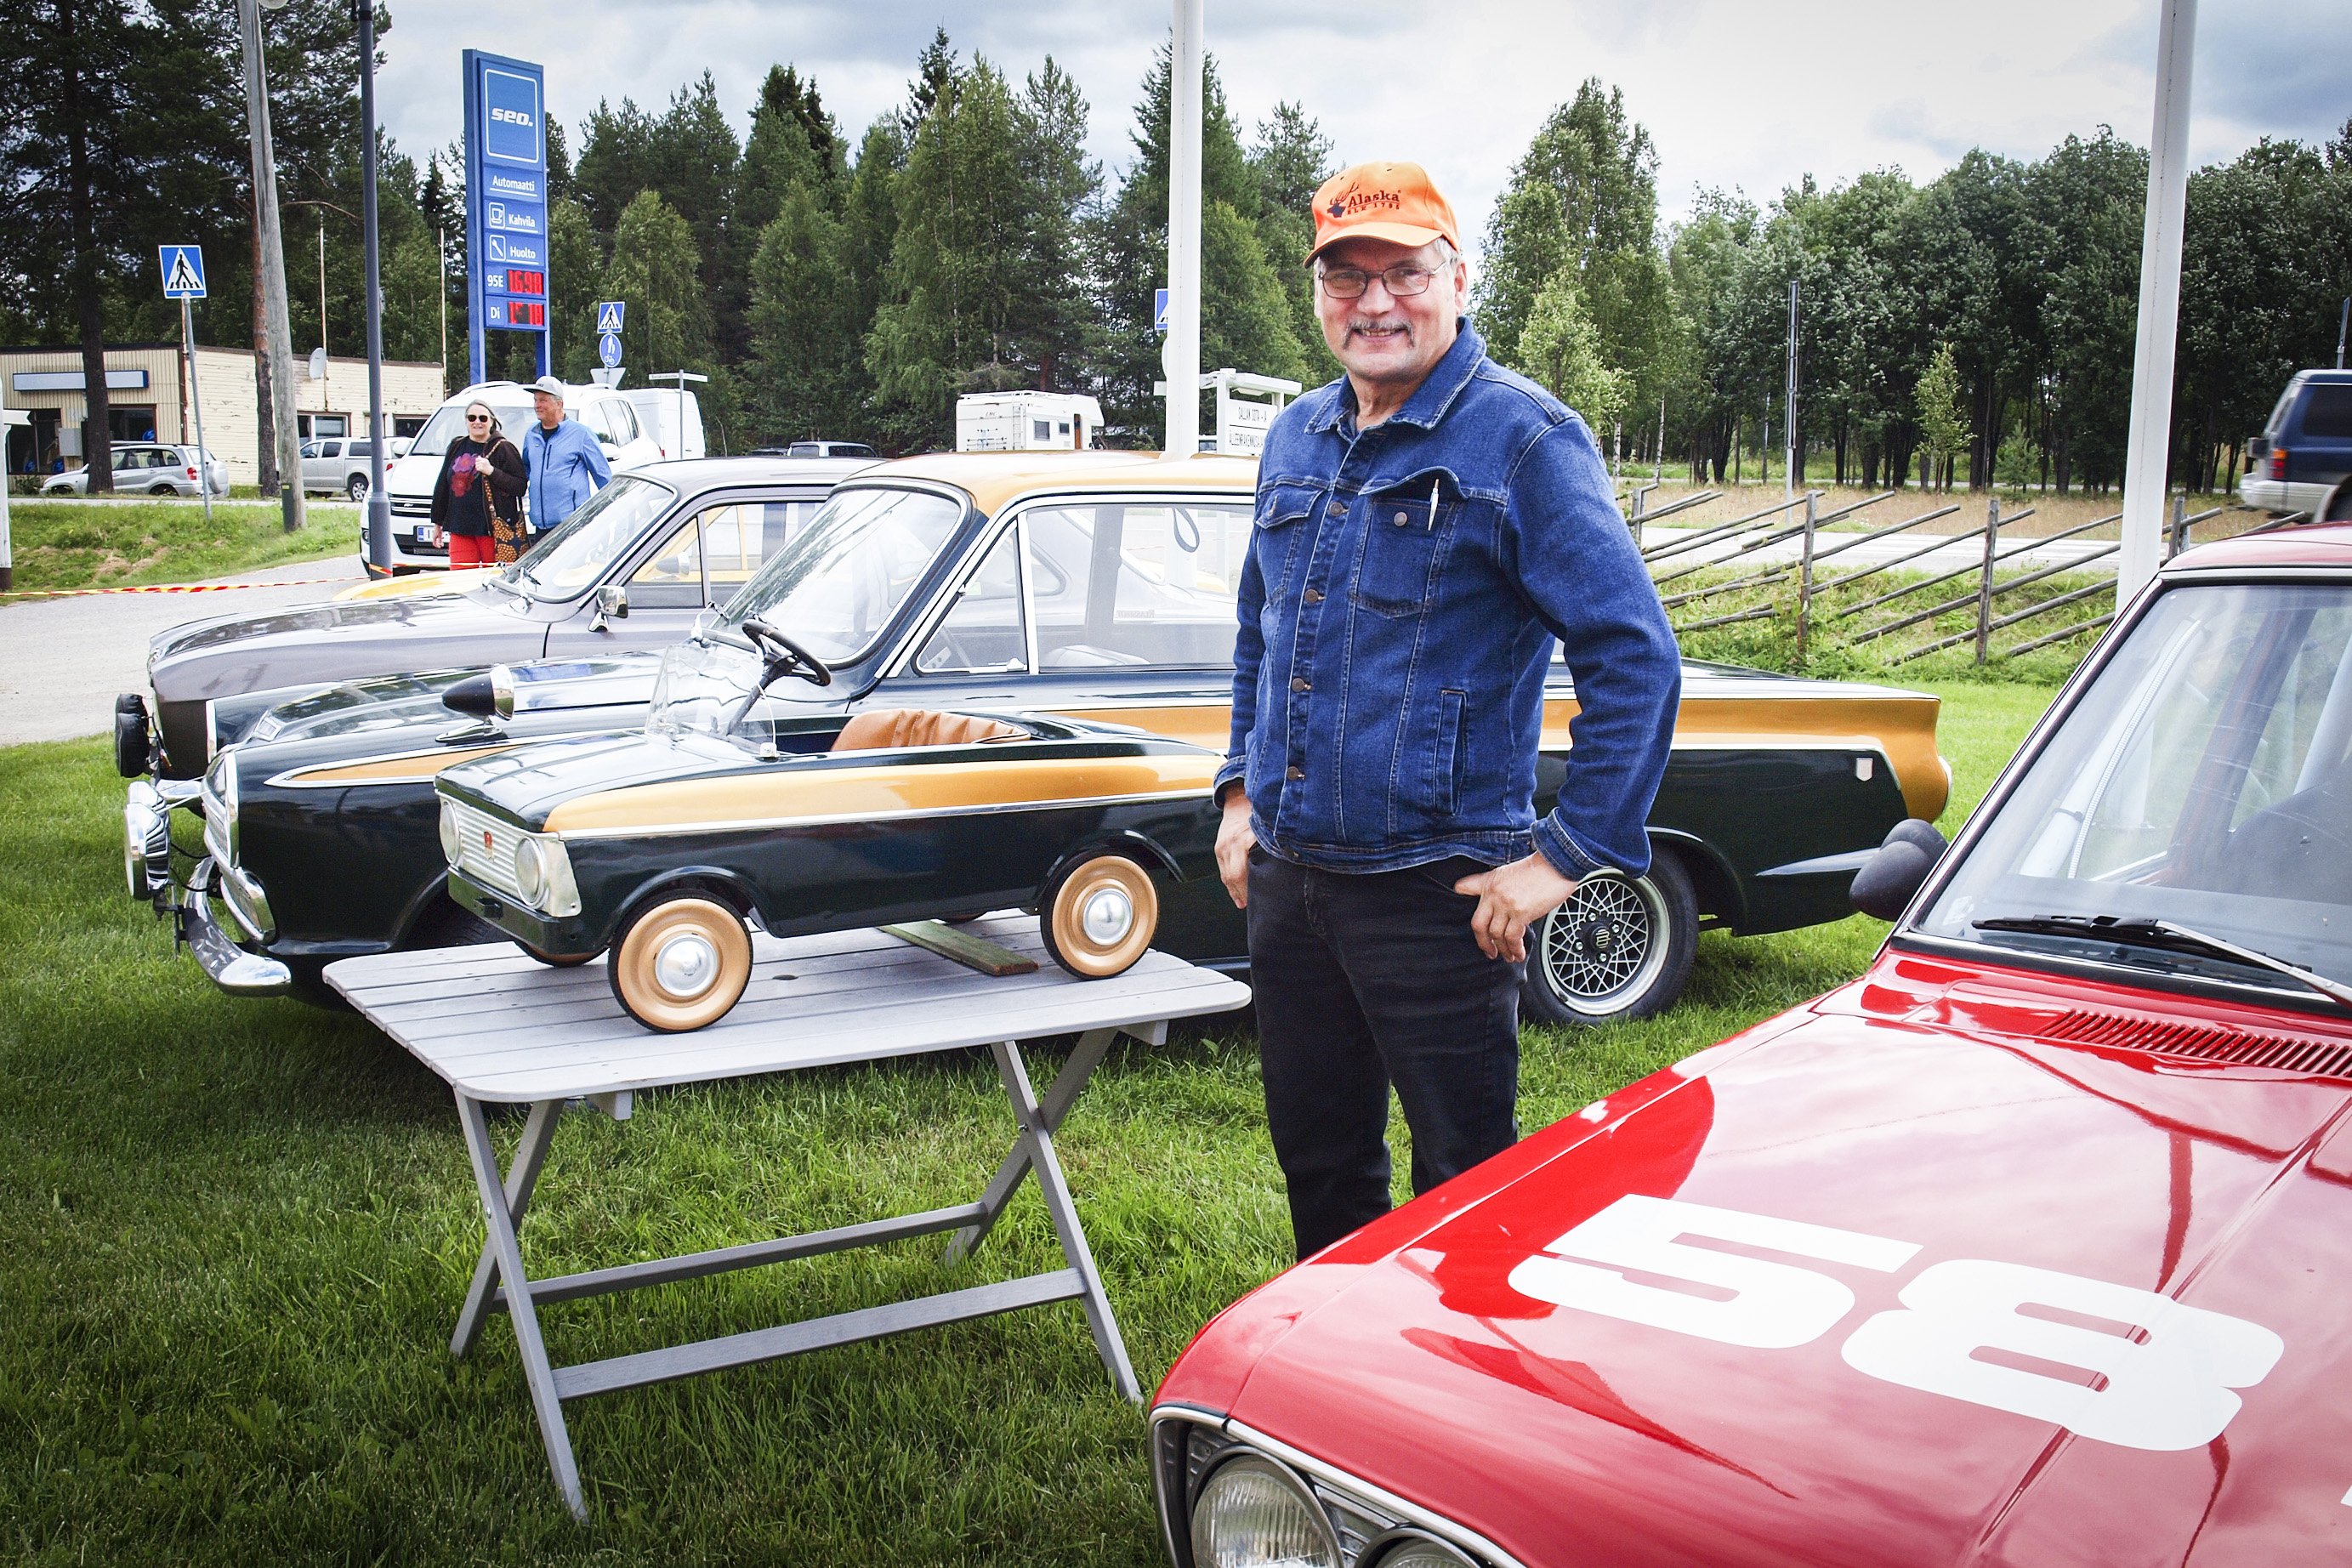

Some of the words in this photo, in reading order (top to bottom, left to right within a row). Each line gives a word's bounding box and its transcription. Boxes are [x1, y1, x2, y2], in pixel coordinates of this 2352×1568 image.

[492, 175, 535, 191] Automaatti
[1347, 190, 1400, 208] Alaska
[508, 213, 536, 227] Kahvila
[510, 246, 536, 259] Huolto
[487, 275, 504, 287] 95E
[490, 306, 501, 320] Di
[1507, 1193, 2285, 1452] 58
